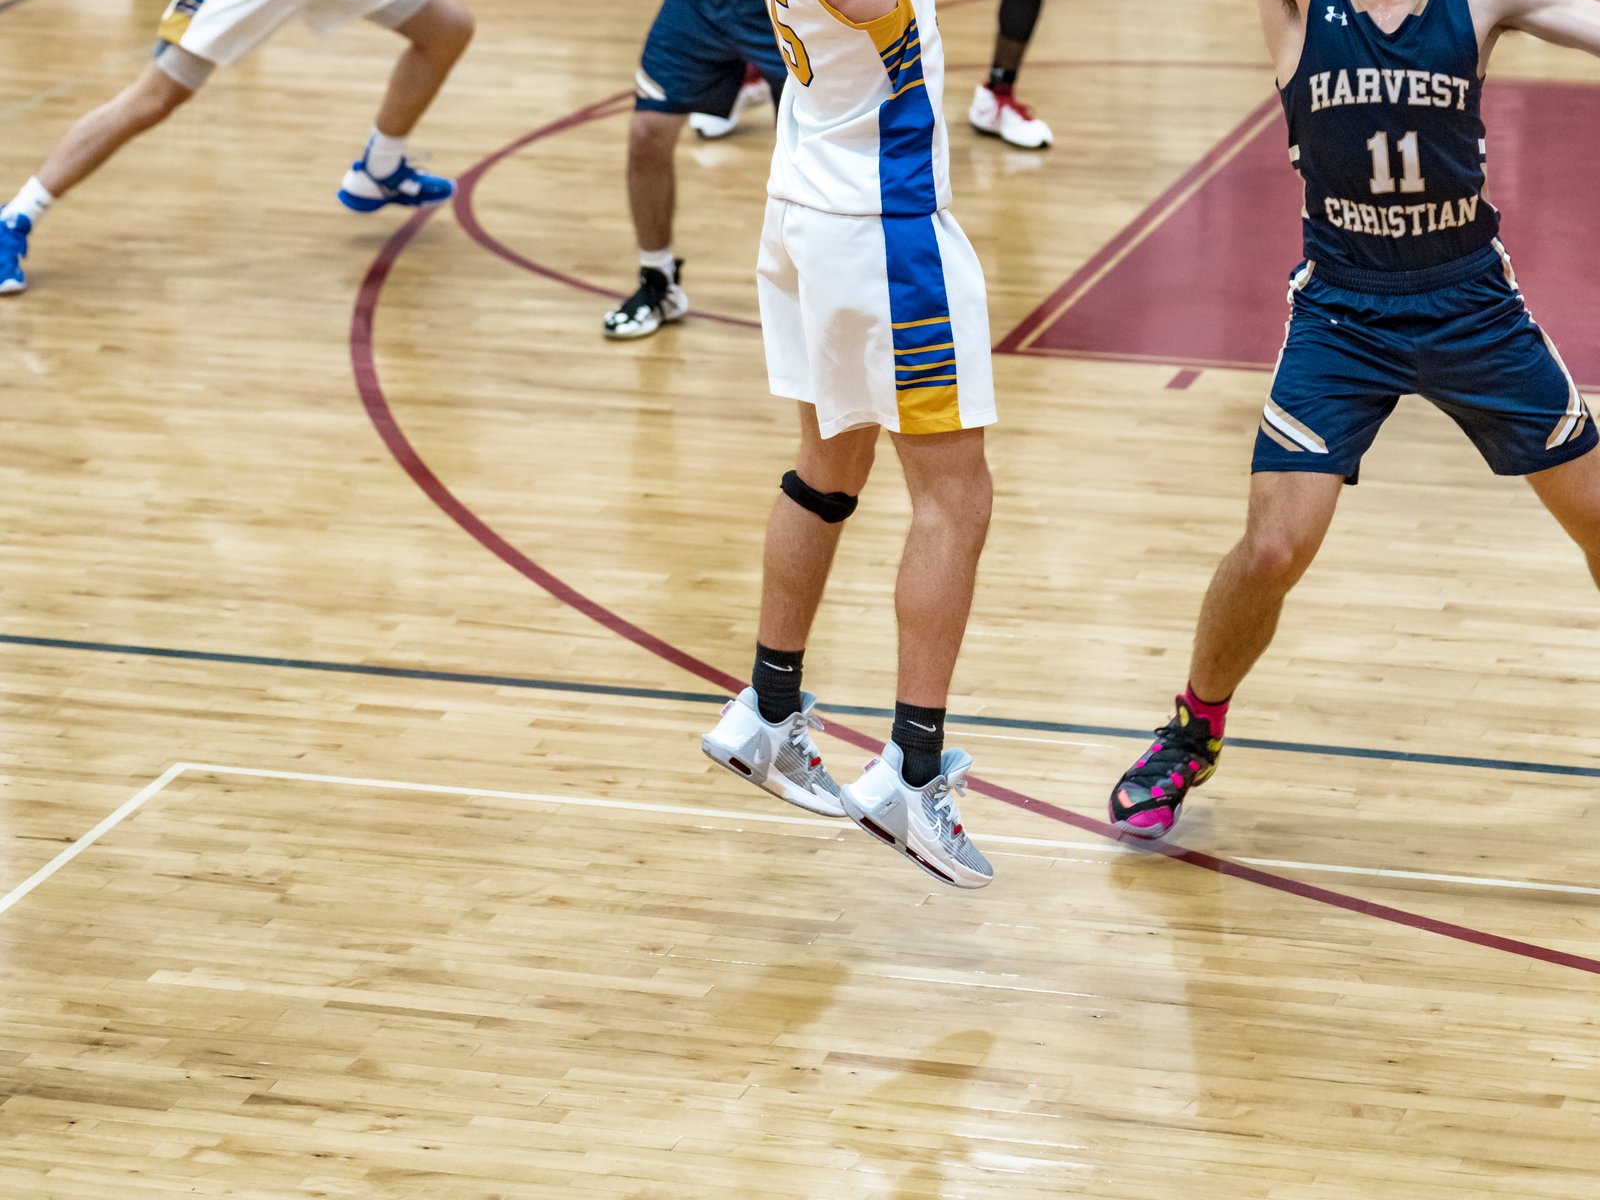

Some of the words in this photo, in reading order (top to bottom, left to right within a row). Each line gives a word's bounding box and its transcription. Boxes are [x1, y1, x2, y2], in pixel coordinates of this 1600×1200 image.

[1309, 67, 1469, 112] HARVEST
[1366, 130, 1425, 195] 11
[1324, 193, 1479, 238] CHRISTIAN
